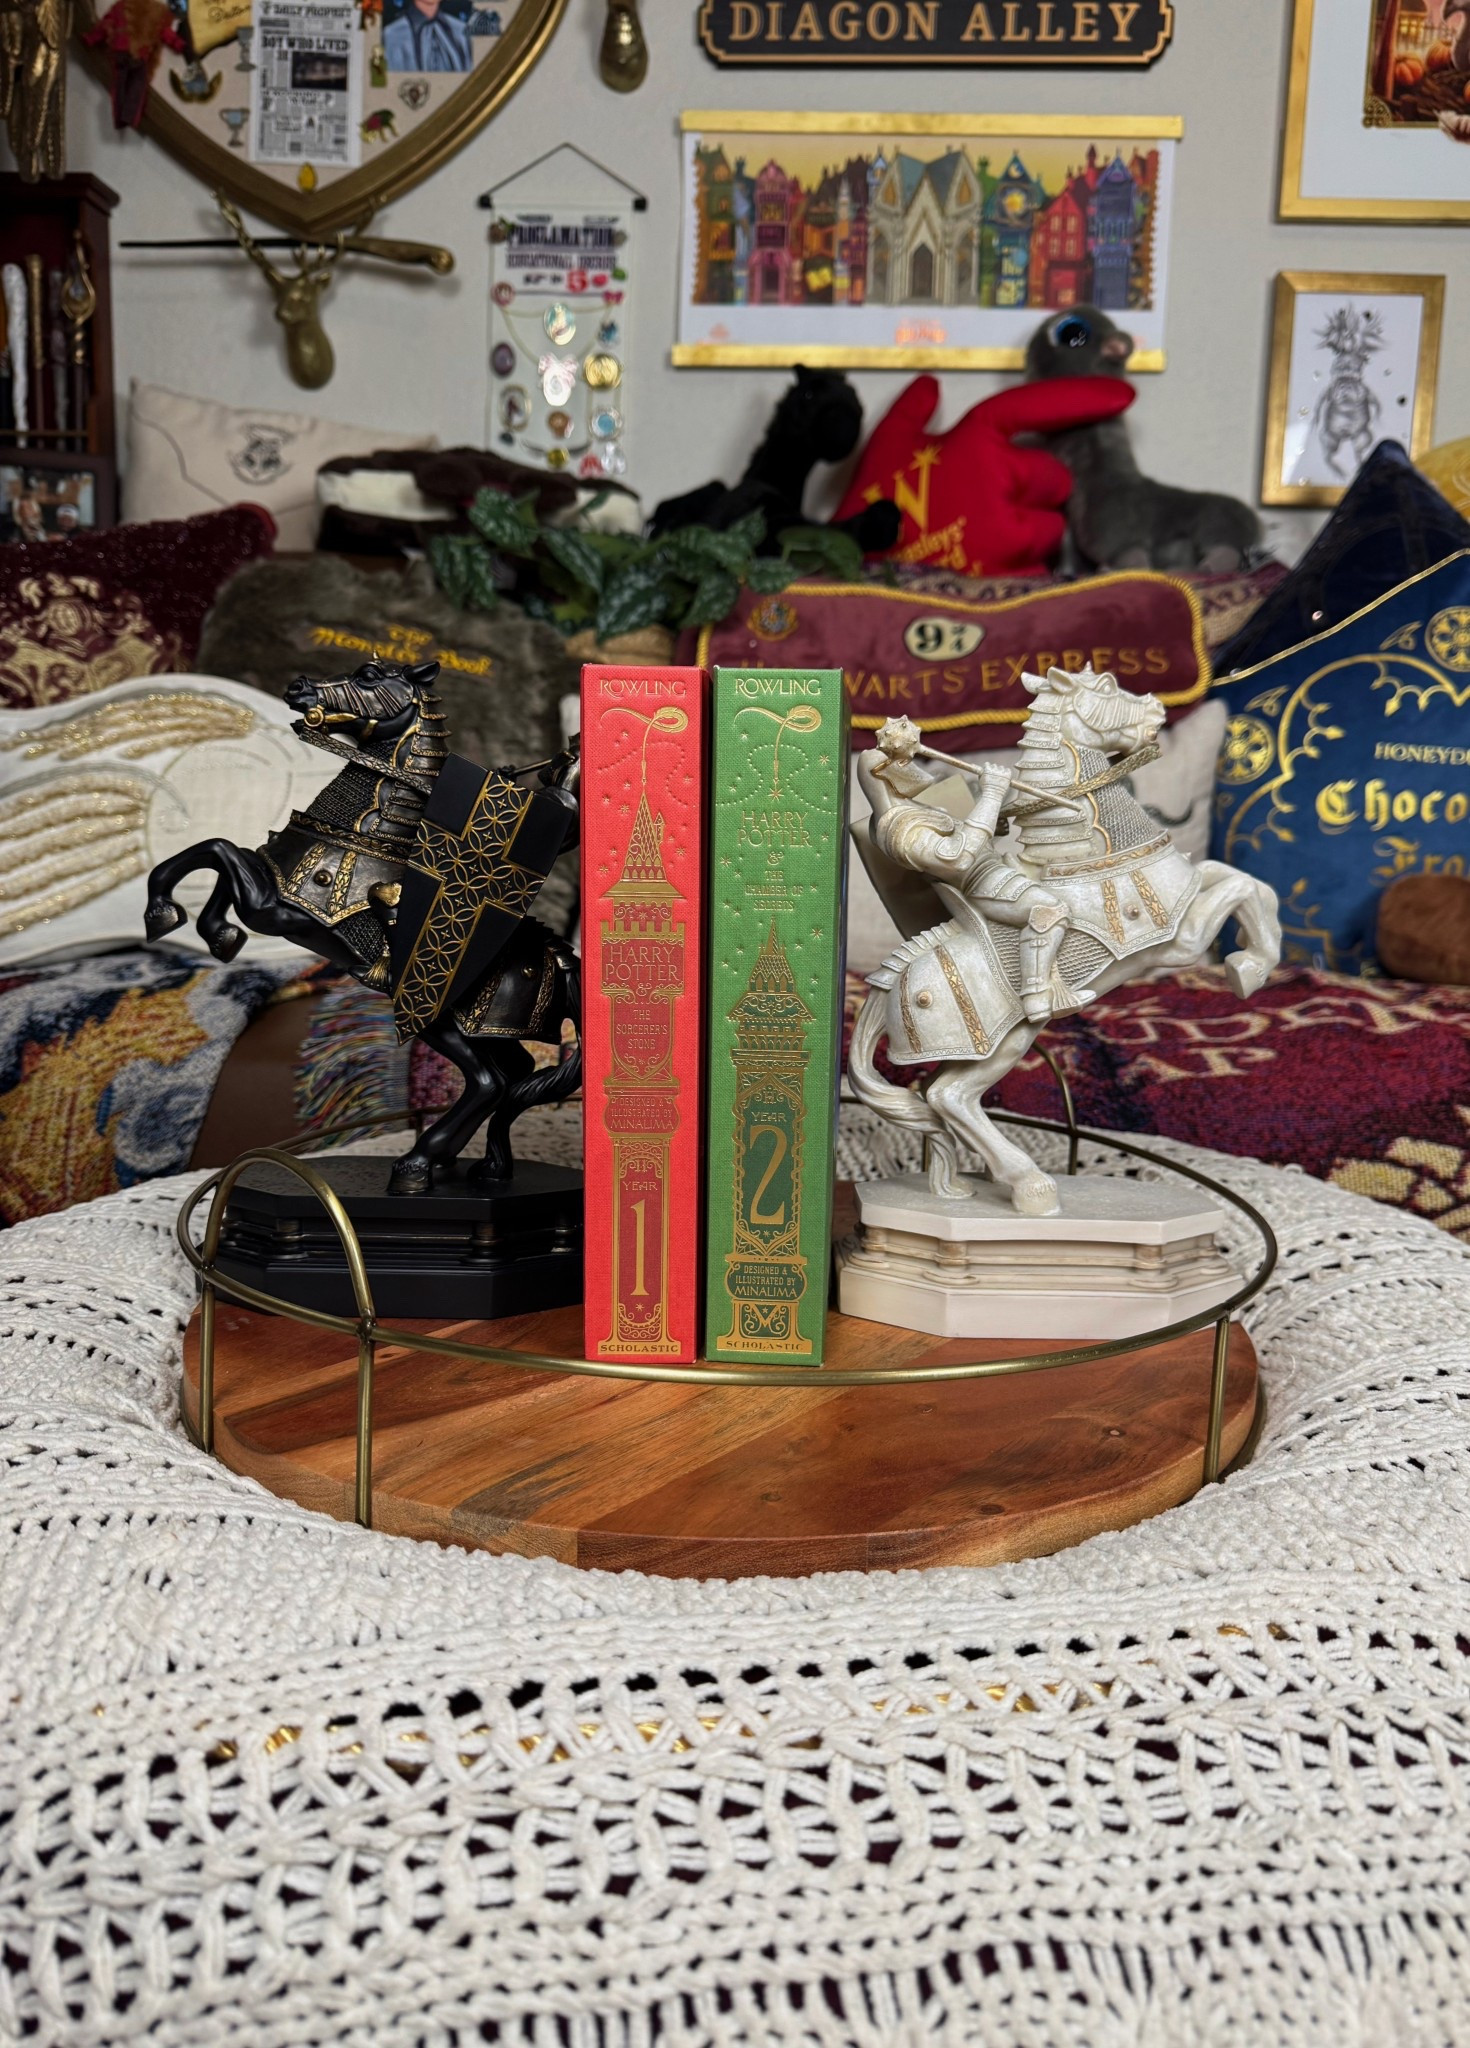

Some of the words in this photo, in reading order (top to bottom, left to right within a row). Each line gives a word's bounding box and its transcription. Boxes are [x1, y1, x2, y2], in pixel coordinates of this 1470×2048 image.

[729, 2, 940, 41] DIAGON
[960, 2, 1141, 42] ALLEY
[981, 647, 1170, 692] EXPRESS
[600, 679, 687, 699] ROWLING
[735, 678, 822, 699] ROWLING
[742, 810, 809, 829] HARRY
[737, 828, 813, 848] POTTER
[767, 851, 784, 866] &
[764, 870, 784, 881] THE
[791, 885, 804, 897] OF
[610, 946, 675, 963] HARRY
[605, 963, 680, 981] POTTER
[635, 982, 653, 997] &
[632, 1009, 651, 1021] THE
[616, 1023, 668, 1035] SORCERER'S
[627, 1038, 656, 1050] STONE
[619, 1097, 656, 1107] DESIGNED
[611, 1107, 661, 1118] ILLUSTRATED
[663, 1109, 673, 1118] BY
[751, 1111, 788, 1122] YEAR
[609, 1119, 675, 1130] MINALIMA
[749, 1124, 788, 1225] 2
[622, 1180, 659, 1191] YEAR
[629, 1198, 651, 1296] 1
[743, 1265, 780, 1275] DESIGNED
[781, 1266, 788, 1275] &
[735, 1275, 784, 1286] ILLUSTRATED
[786, 1277, 797, 1287] BY
[734, 1286, 798, 1298] MINALIMA
[600, 1344, 679, 1353] SCHOLASTIC
[726, 1340, 804, 1351] SCHOLASTIC
